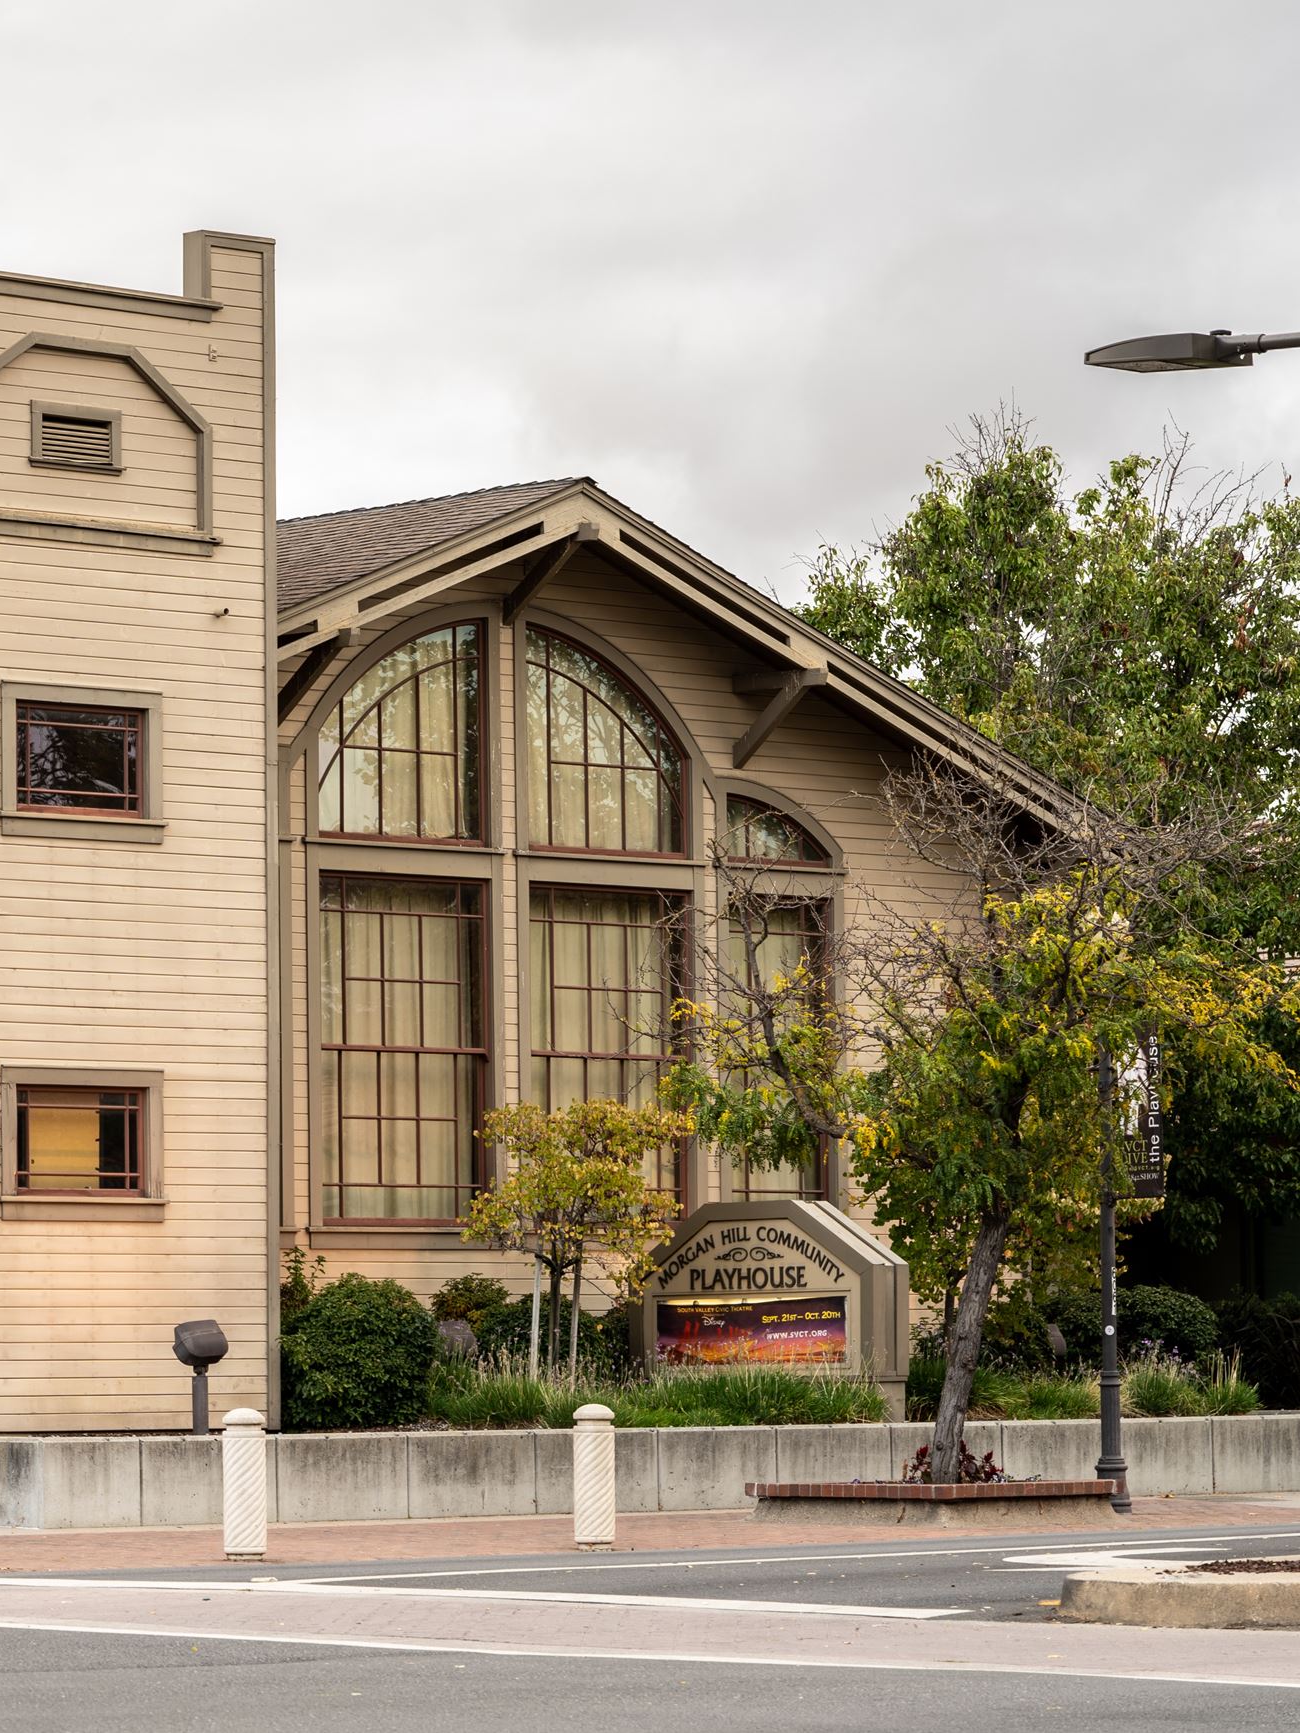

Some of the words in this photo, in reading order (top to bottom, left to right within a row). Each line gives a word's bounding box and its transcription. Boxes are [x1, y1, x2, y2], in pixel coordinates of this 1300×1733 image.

[1120, 1140, 1148, 1151] VCT
[1149, 1134, 1160, 1163] the
[658, 1234, 716, 1290] MORGAN
[721, 1226, 751, 1246] HILL
[756, 1226, 845, 1284] COMMUNITY
[689, 1265, 808, 1291] PLAYHOUSE
[677, 1306, 695, 1314] SOUTH
[821, 1310, 841, 1319] 20TH
[701, 1316, 725, 1328] Disney
[766, 1329, 828, 1340] WWW.SVCT.ORG
